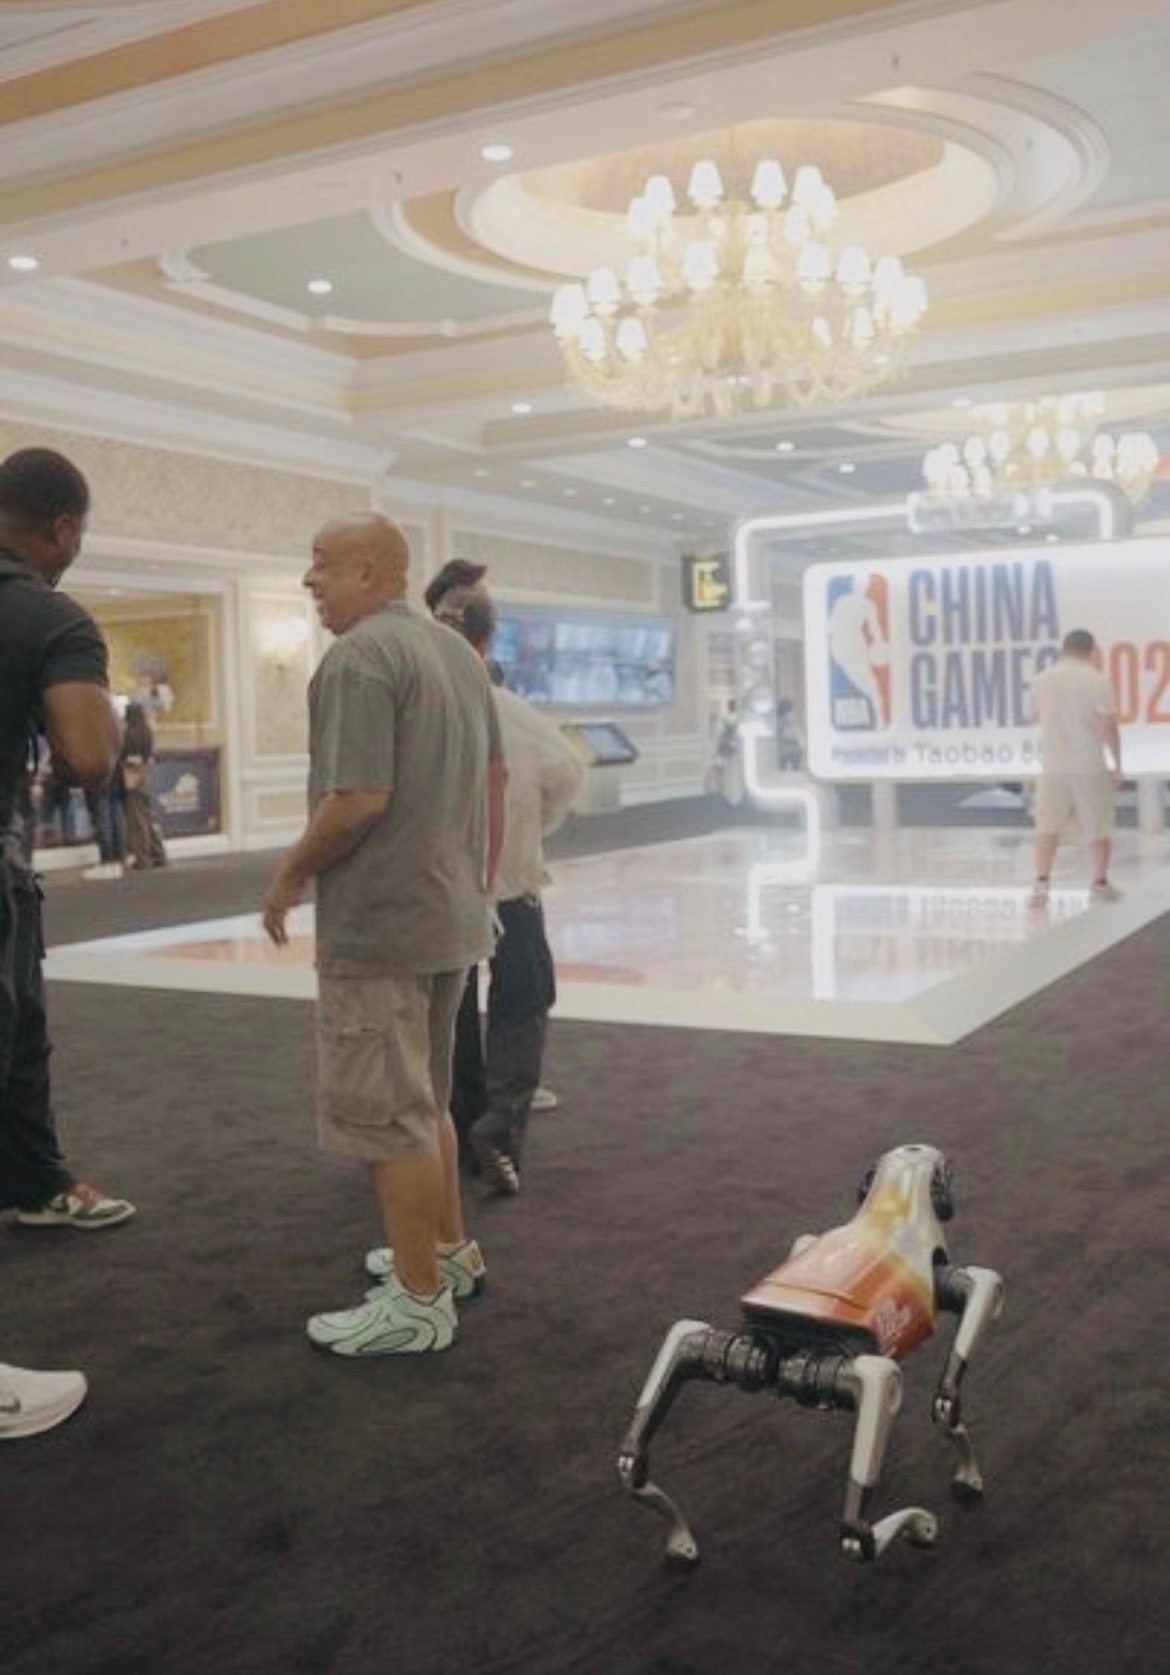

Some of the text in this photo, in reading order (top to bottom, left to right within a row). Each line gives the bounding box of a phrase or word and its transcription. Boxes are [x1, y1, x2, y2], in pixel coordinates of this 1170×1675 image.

[909, 559, 1060, 646] CHINA
[1092, 641, 1170, 725] 02
[913, 741, 1012, 764] Taobao
